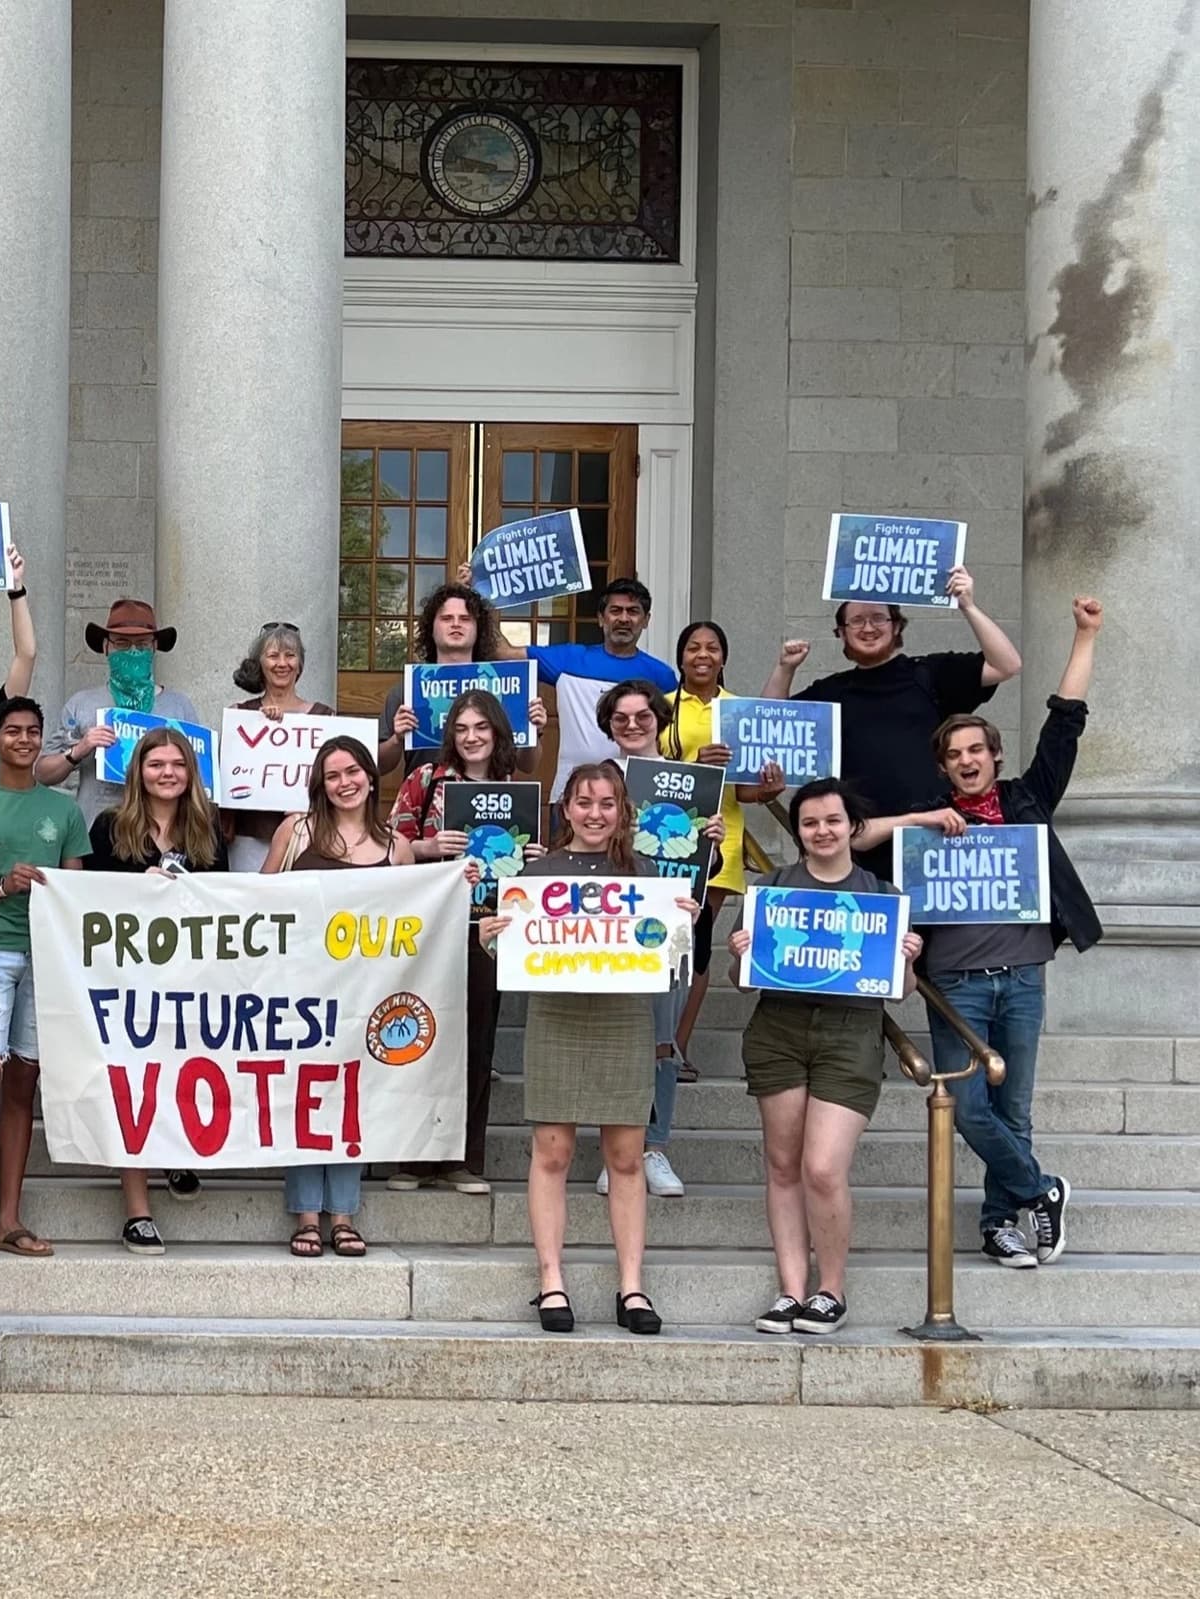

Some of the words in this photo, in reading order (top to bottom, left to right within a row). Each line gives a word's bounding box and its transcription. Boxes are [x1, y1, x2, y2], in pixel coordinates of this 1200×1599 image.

[496, 529, 522, 542] Fight
[523, 526, 538, 537] for
[875, 523, 903, 535] Fight
[905, 525, 921, 535] for
[483, 533, 560, 571] CLIMATE
[854, 535, 939, 566] CLIMATE
[490, 559, 567, 600] JUSTICE
[849, 563, 938, 595] JUSTICE
[420, 679, 458, 698] VOTE
[492, 676, 521, 695] OUR
[755, 705, 780, 718] Fight
[782, 706, 798, 717] for
[113, 720, 147, 740] VOTE
[237, 724, 325, 750] VOTE
[512, 732, 527, 744] 50
[738, 717, 817, 747] CLIMATE
[736, 745, 818, 777] JUSTICE
[654, 789, 692, 801] ACTION
[656, 771, 696, 793] 350
[474, 794, 513, 812] 350
[474, 811, 511, 820] ACTION
[977, 834, 995, 845] for
[923, 847, 1019, 878] CLIMATE
[922, 880, 1021, 912] JUSTICE
[524, 919, 631, 945] CLIMATE
[765, 906, 809, 930] VOTE
[813, 909, 847, 933] FOR
[851, 911, 888, 935] OUR
[82, 911, 296, 968] PROTECT
[324, 910, 423, 961] OUR
[524, 950, 663, 976] CHAMPIONS
[784, 946, 863, 972] FUTURES
[858, 978, 890, 993] 350
[88, 988, 339, 1052] FUTURES!
[107, 1056, 362, 1159] VOTE!
